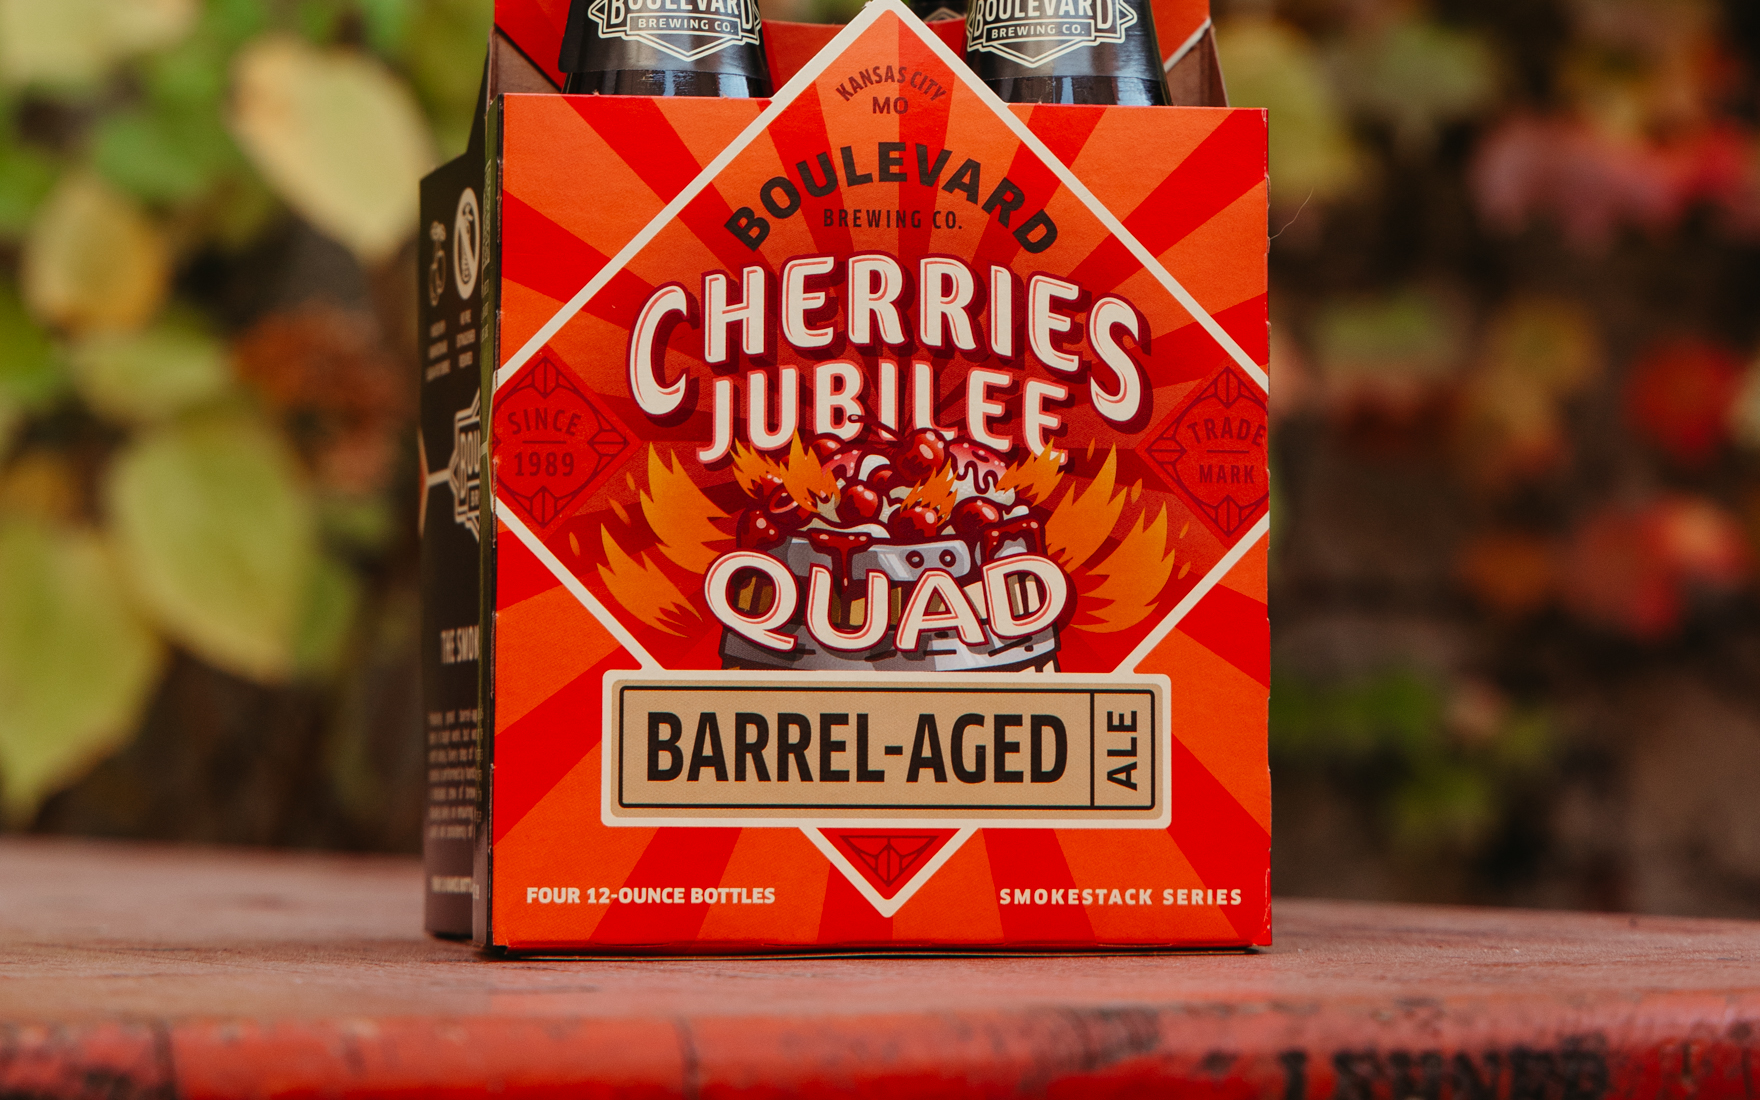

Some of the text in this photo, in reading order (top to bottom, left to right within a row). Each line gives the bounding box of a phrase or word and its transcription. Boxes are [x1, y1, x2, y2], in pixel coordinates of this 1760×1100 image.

[638, 17, 735, 33] BREWING CO.
[991, 22, 1085, 39] BREWING CO.
[835, 65, 947, 102] KANSAS CITY
[872, 96, 908, 115] MO
[724, 141, 1058, 254] BOULEVARD
[823, 208, 963, 230] BREWING CO.
[627, 253, 1143, 422] CHERRIES
[507, 407, 581, 437] SINCE
[696, 359, 1070, 467] JUBILEE
[1187, 416, 1267, 447] TRADE
[514, 451, 575, 477] 1989
[1200, 464, 1255, 484] MARK
[703, 550, 1069, 652] QUAD
[646, 711, 1068, 784] BARREL-AGED
[1106, 710, 1138, 791] ALE
[526, 887, 776, 904] FOUR 12-OUNCE BOTTLES
[1000, 888, 1242, 906] SMOKESTACK SERIES
